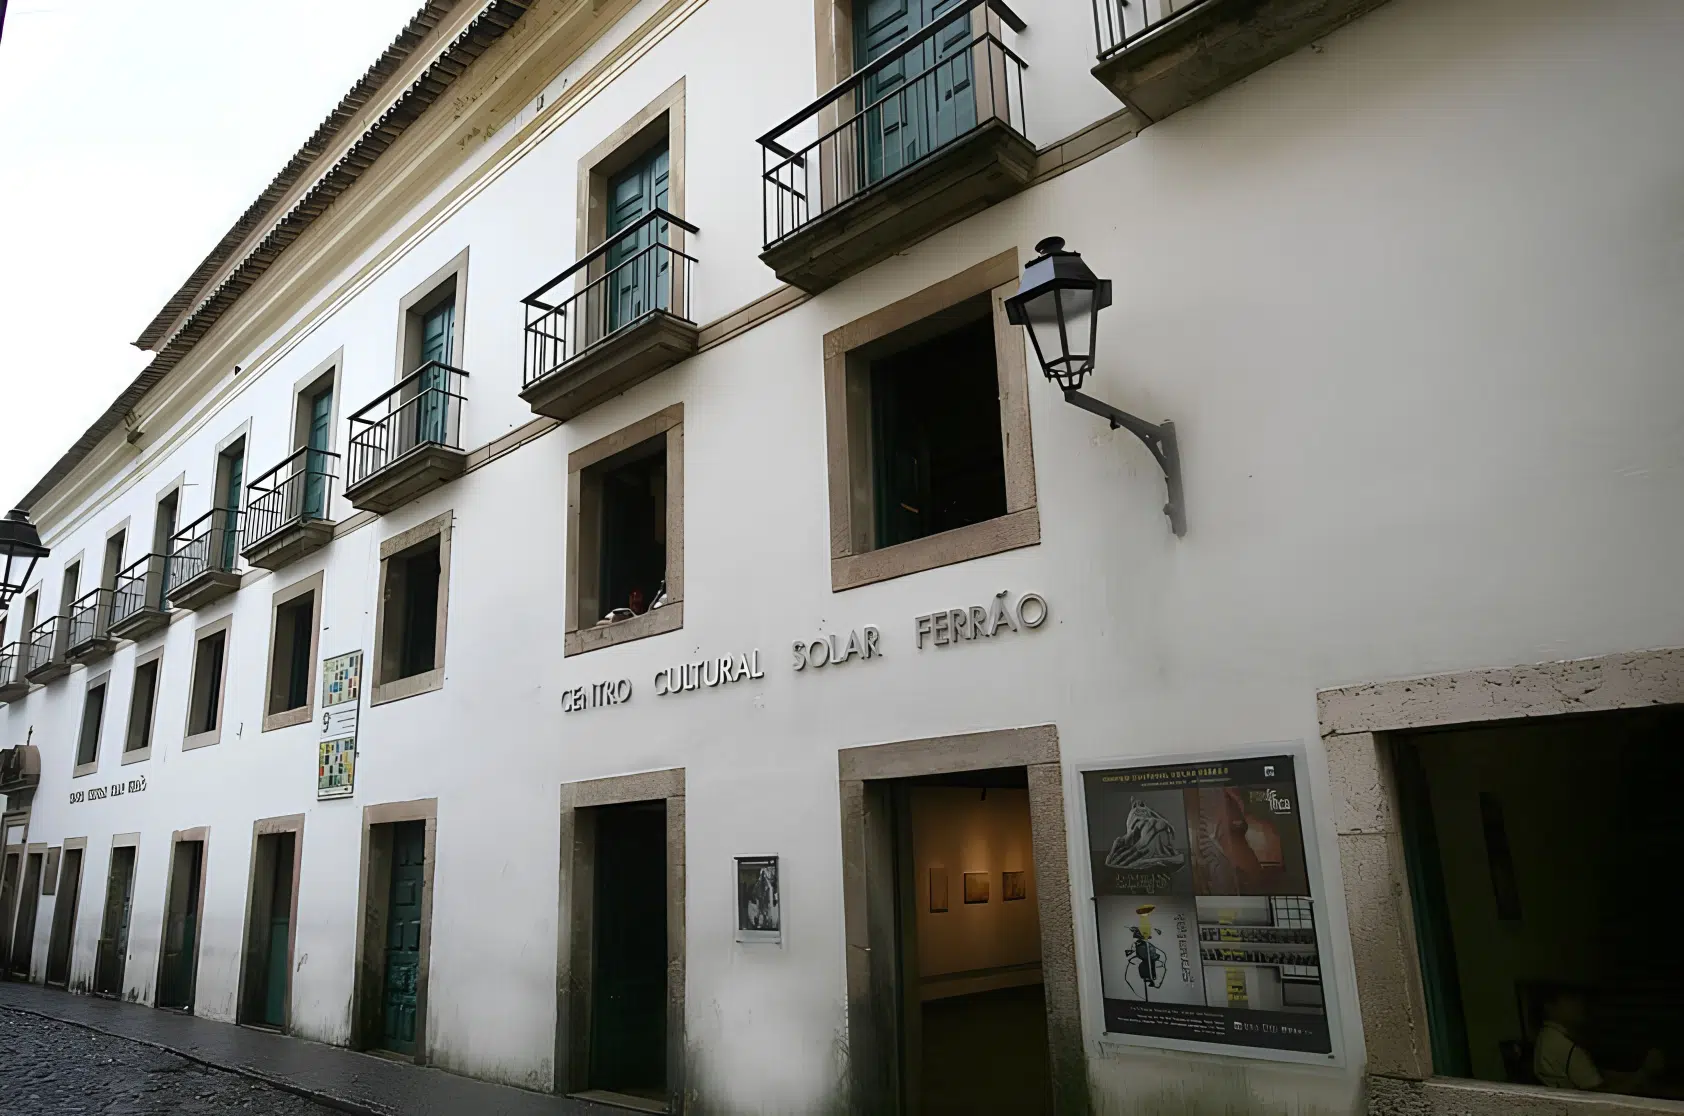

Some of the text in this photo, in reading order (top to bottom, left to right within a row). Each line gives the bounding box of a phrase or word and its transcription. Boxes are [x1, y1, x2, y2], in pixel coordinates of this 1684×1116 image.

[561, 589, 1048, 713] CENTRO CULTURAL SOLAR FERRÃO
